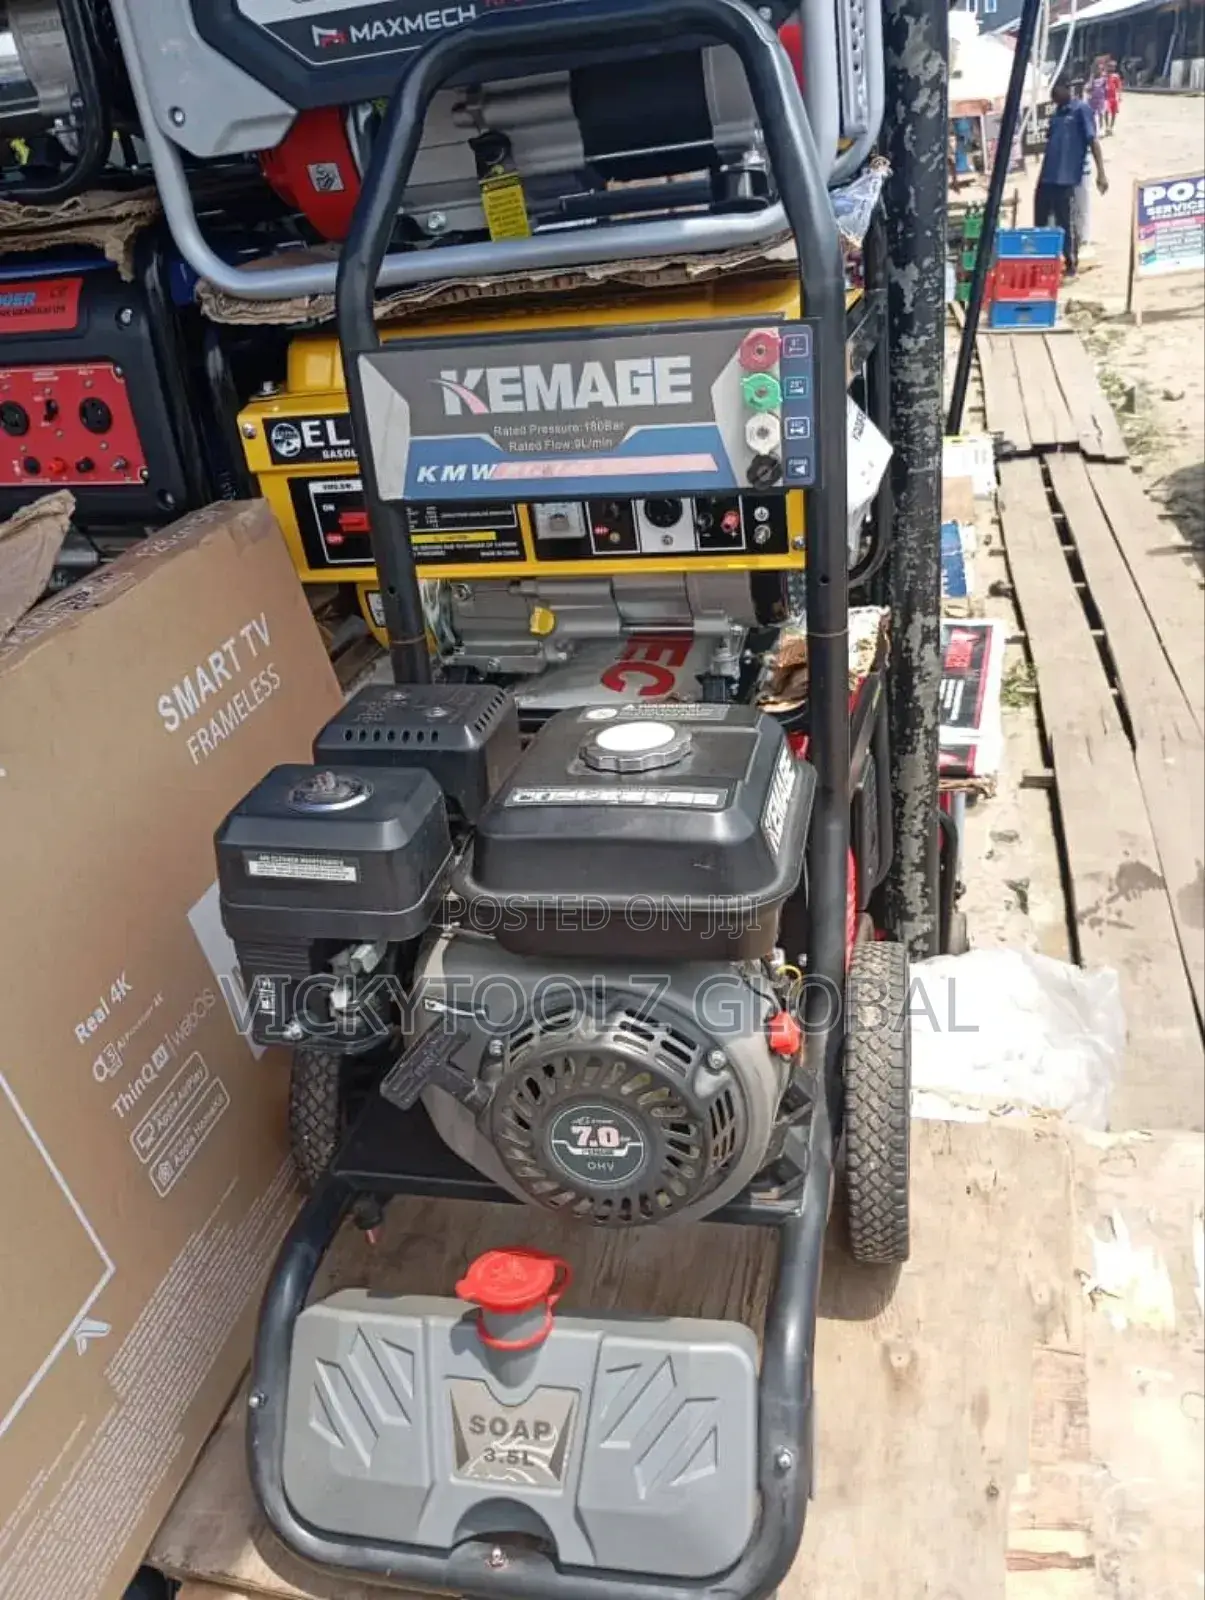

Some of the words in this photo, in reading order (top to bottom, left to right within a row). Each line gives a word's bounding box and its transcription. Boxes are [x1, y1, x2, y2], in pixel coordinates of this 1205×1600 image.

[350, 5, 476, 43] MAXMECH
[438, 356, 692, 415] KEMAGE
[494, 425, 526, 437] Rated
[509, 440, 542, 452] Rated
[158, 637, 241, 732] SMART
[240, 612, 270, 657] TV
[186, 662, 281, 765] FRAMELESS
[74, 996, 111, 1044] Real
[110, 971, 133, 1003] 4K
[111, 1063, 158, 1118] ThinQ
[570, 1125, 620, 1148] 7.0
[587, 1160, 615, 1172] OHV
[468, 1414, 551, 1440] SOAP
[484, 1447, 534, 1467] 3.5L
